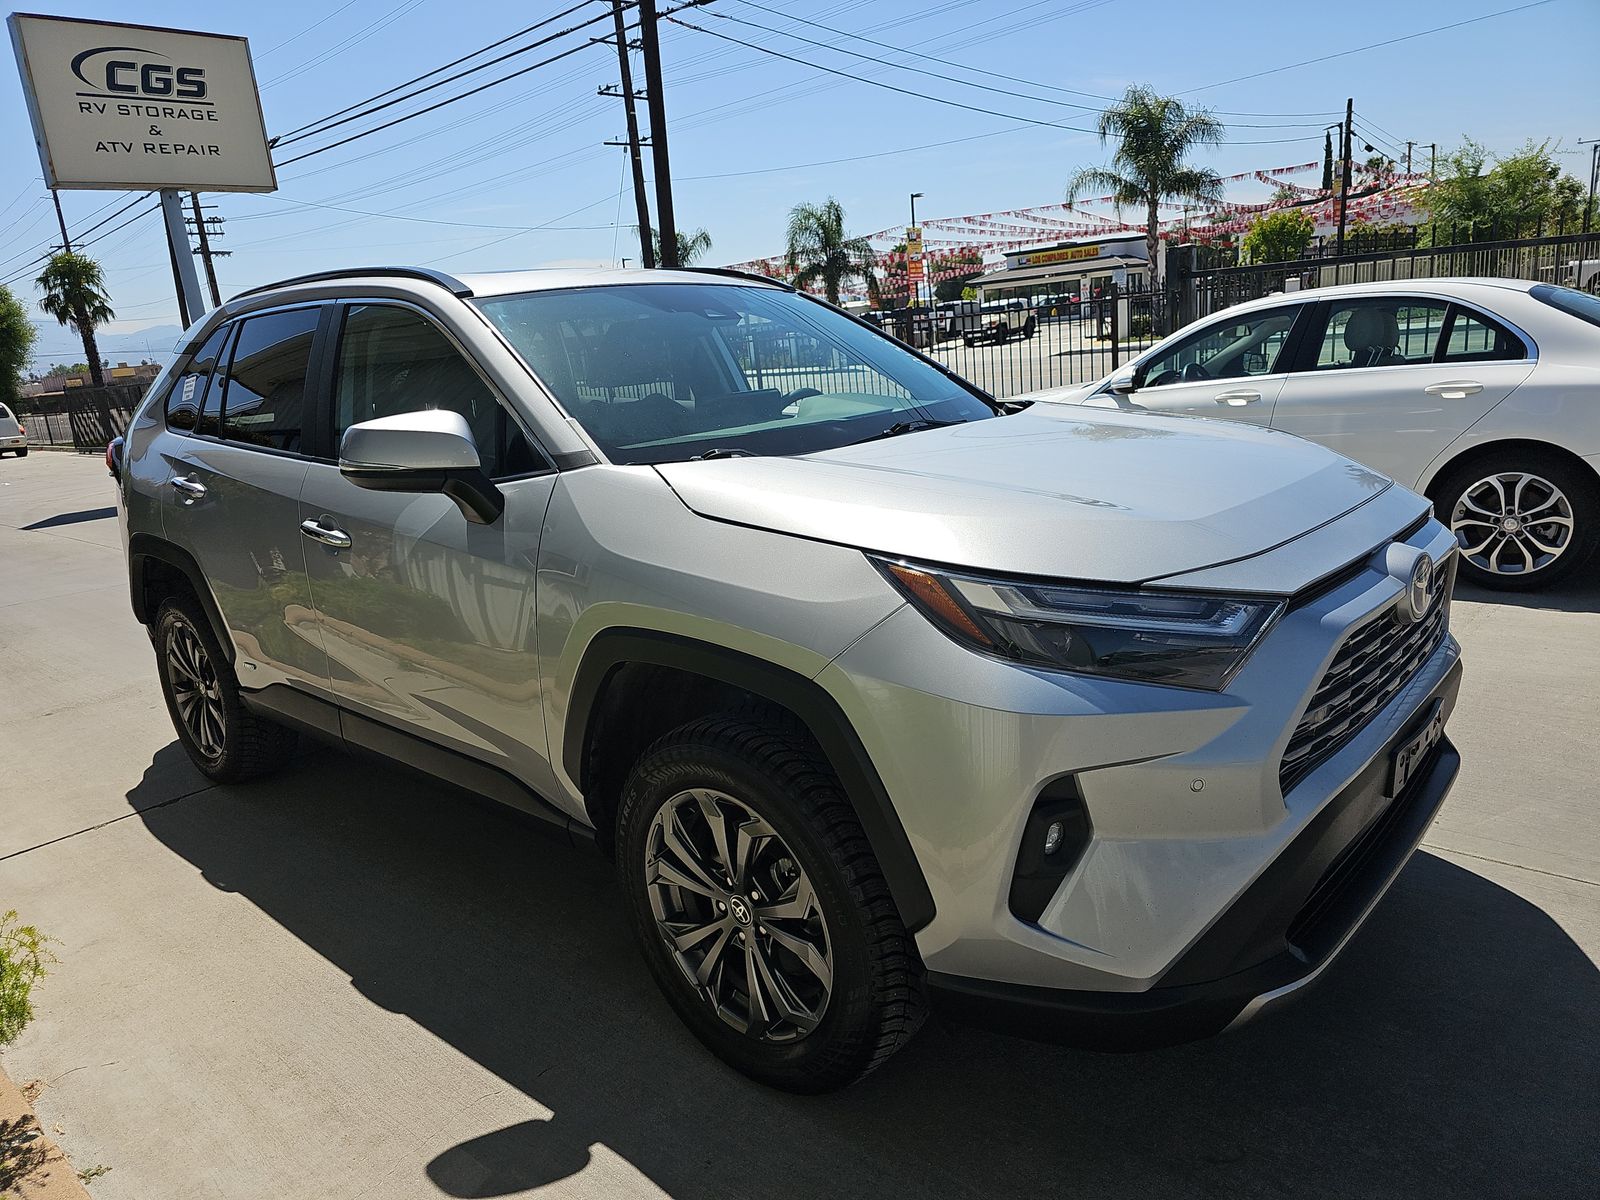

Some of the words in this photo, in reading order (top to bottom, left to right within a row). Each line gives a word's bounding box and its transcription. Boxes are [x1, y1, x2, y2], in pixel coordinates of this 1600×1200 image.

[106, 60, 208, 99] CGS
[79, 102, 106, 115] RV
[117, 104, 219, 122] STORAGE
[149, 125, 162, 136] &
[95, 141, 133, 154] ATV
[143, 143, 221, 156] REPAIR
[619, 788, 637, 836] TYRES
